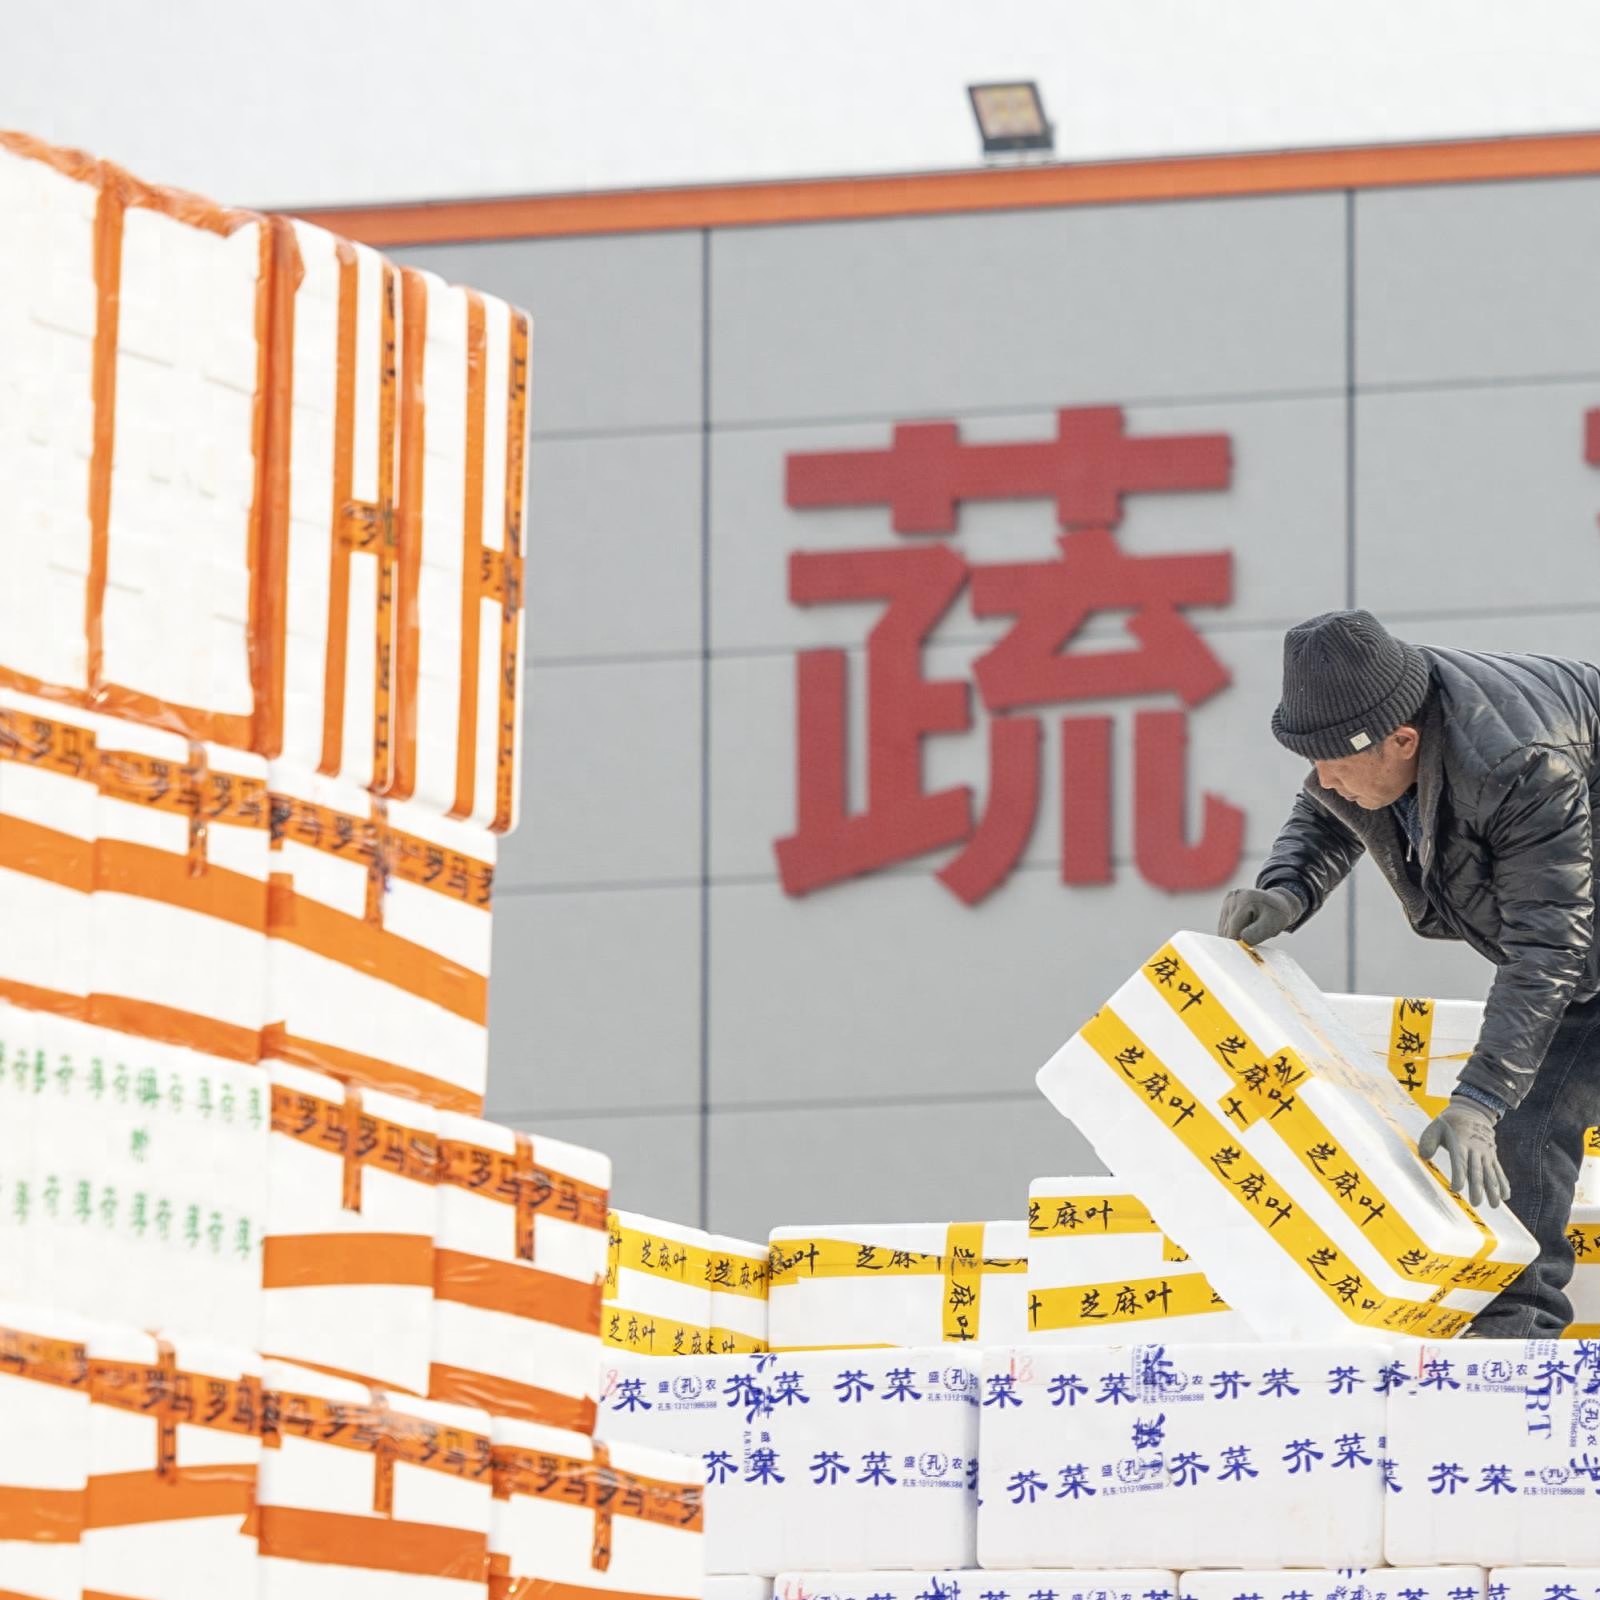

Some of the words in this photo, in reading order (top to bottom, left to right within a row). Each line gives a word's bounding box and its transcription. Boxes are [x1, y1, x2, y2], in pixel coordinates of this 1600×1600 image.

[1114, 1046, 1196, 1126] 芝麻叶
[1210, 1146, 1292, 1227] 芝麻叶
[1306, 1248, 1375, 1309] 芝麻叶
[1306, 1143, 1385, 1225] 芝麻叶
[641, 1244, 686, 1268] 芝麻叶
[1080, 1281, 1171, 1318] 芝麻叶
[607, 1313, 658, 1352] 芝麻叶
[833, 1367, 923, 1404] 芥菜
[1046, 1371, 1139, 1407] 芥菜
[1213, 1367, 1301, 1400] 芥菜
[809, 1450, 897, 1488] 芥菜
[1168, 1445, 1259, 1488] 芥菜
[1282, 1433, 1374, 1474] 芥菜
[1428, 1461, 1518, 1496] 芥菜
[1007, 1462, 1097, 1505] 芥菜
